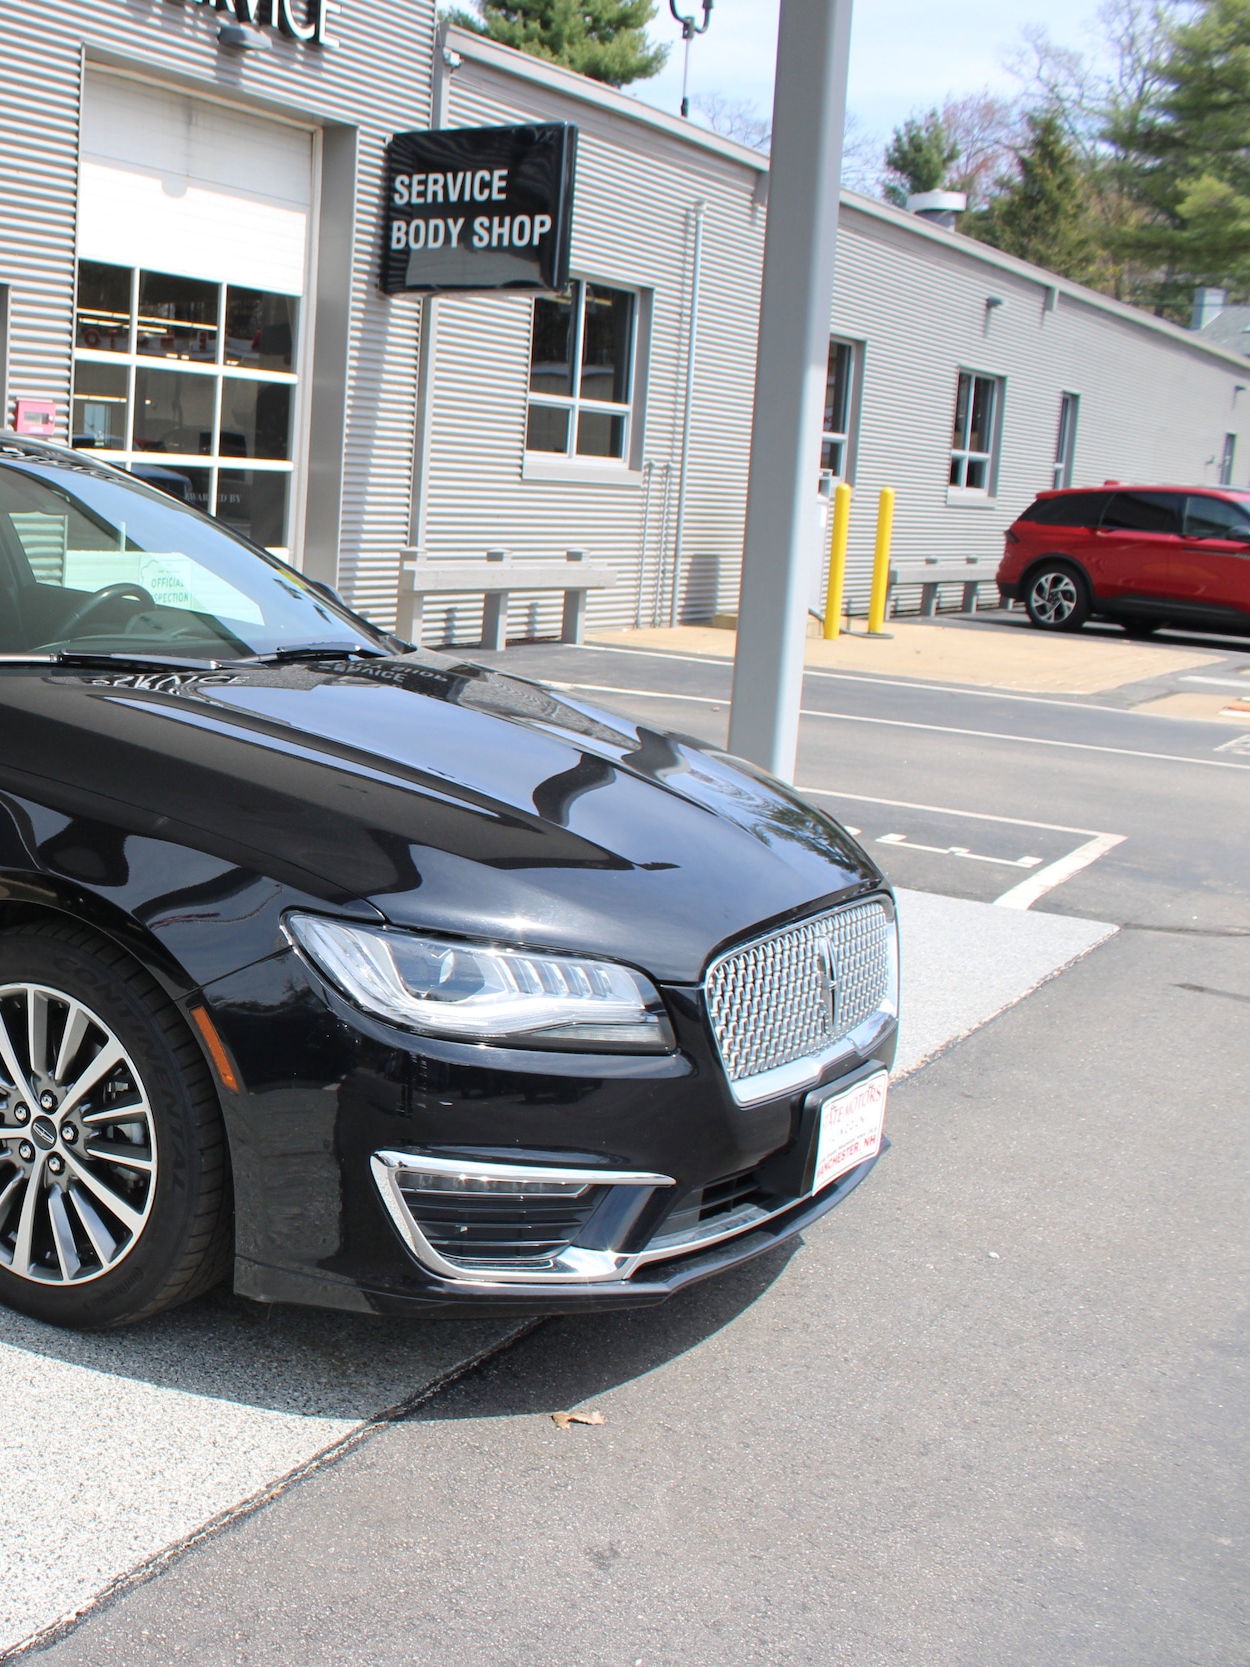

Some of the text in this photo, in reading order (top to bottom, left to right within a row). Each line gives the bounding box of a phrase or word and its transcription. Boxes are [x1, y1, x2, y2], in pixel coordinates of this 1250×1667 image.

[393, 168, 509, 206] SERVICE
[391, 213, 552, 250] BODY SHOP
[151, 577, 184, 589] OFFICIAL
[153, 592, 189, 603] SPECTION
[845, 1085, 882, 1115] MOTORS
[863, 1134, 876, 1147] NH
